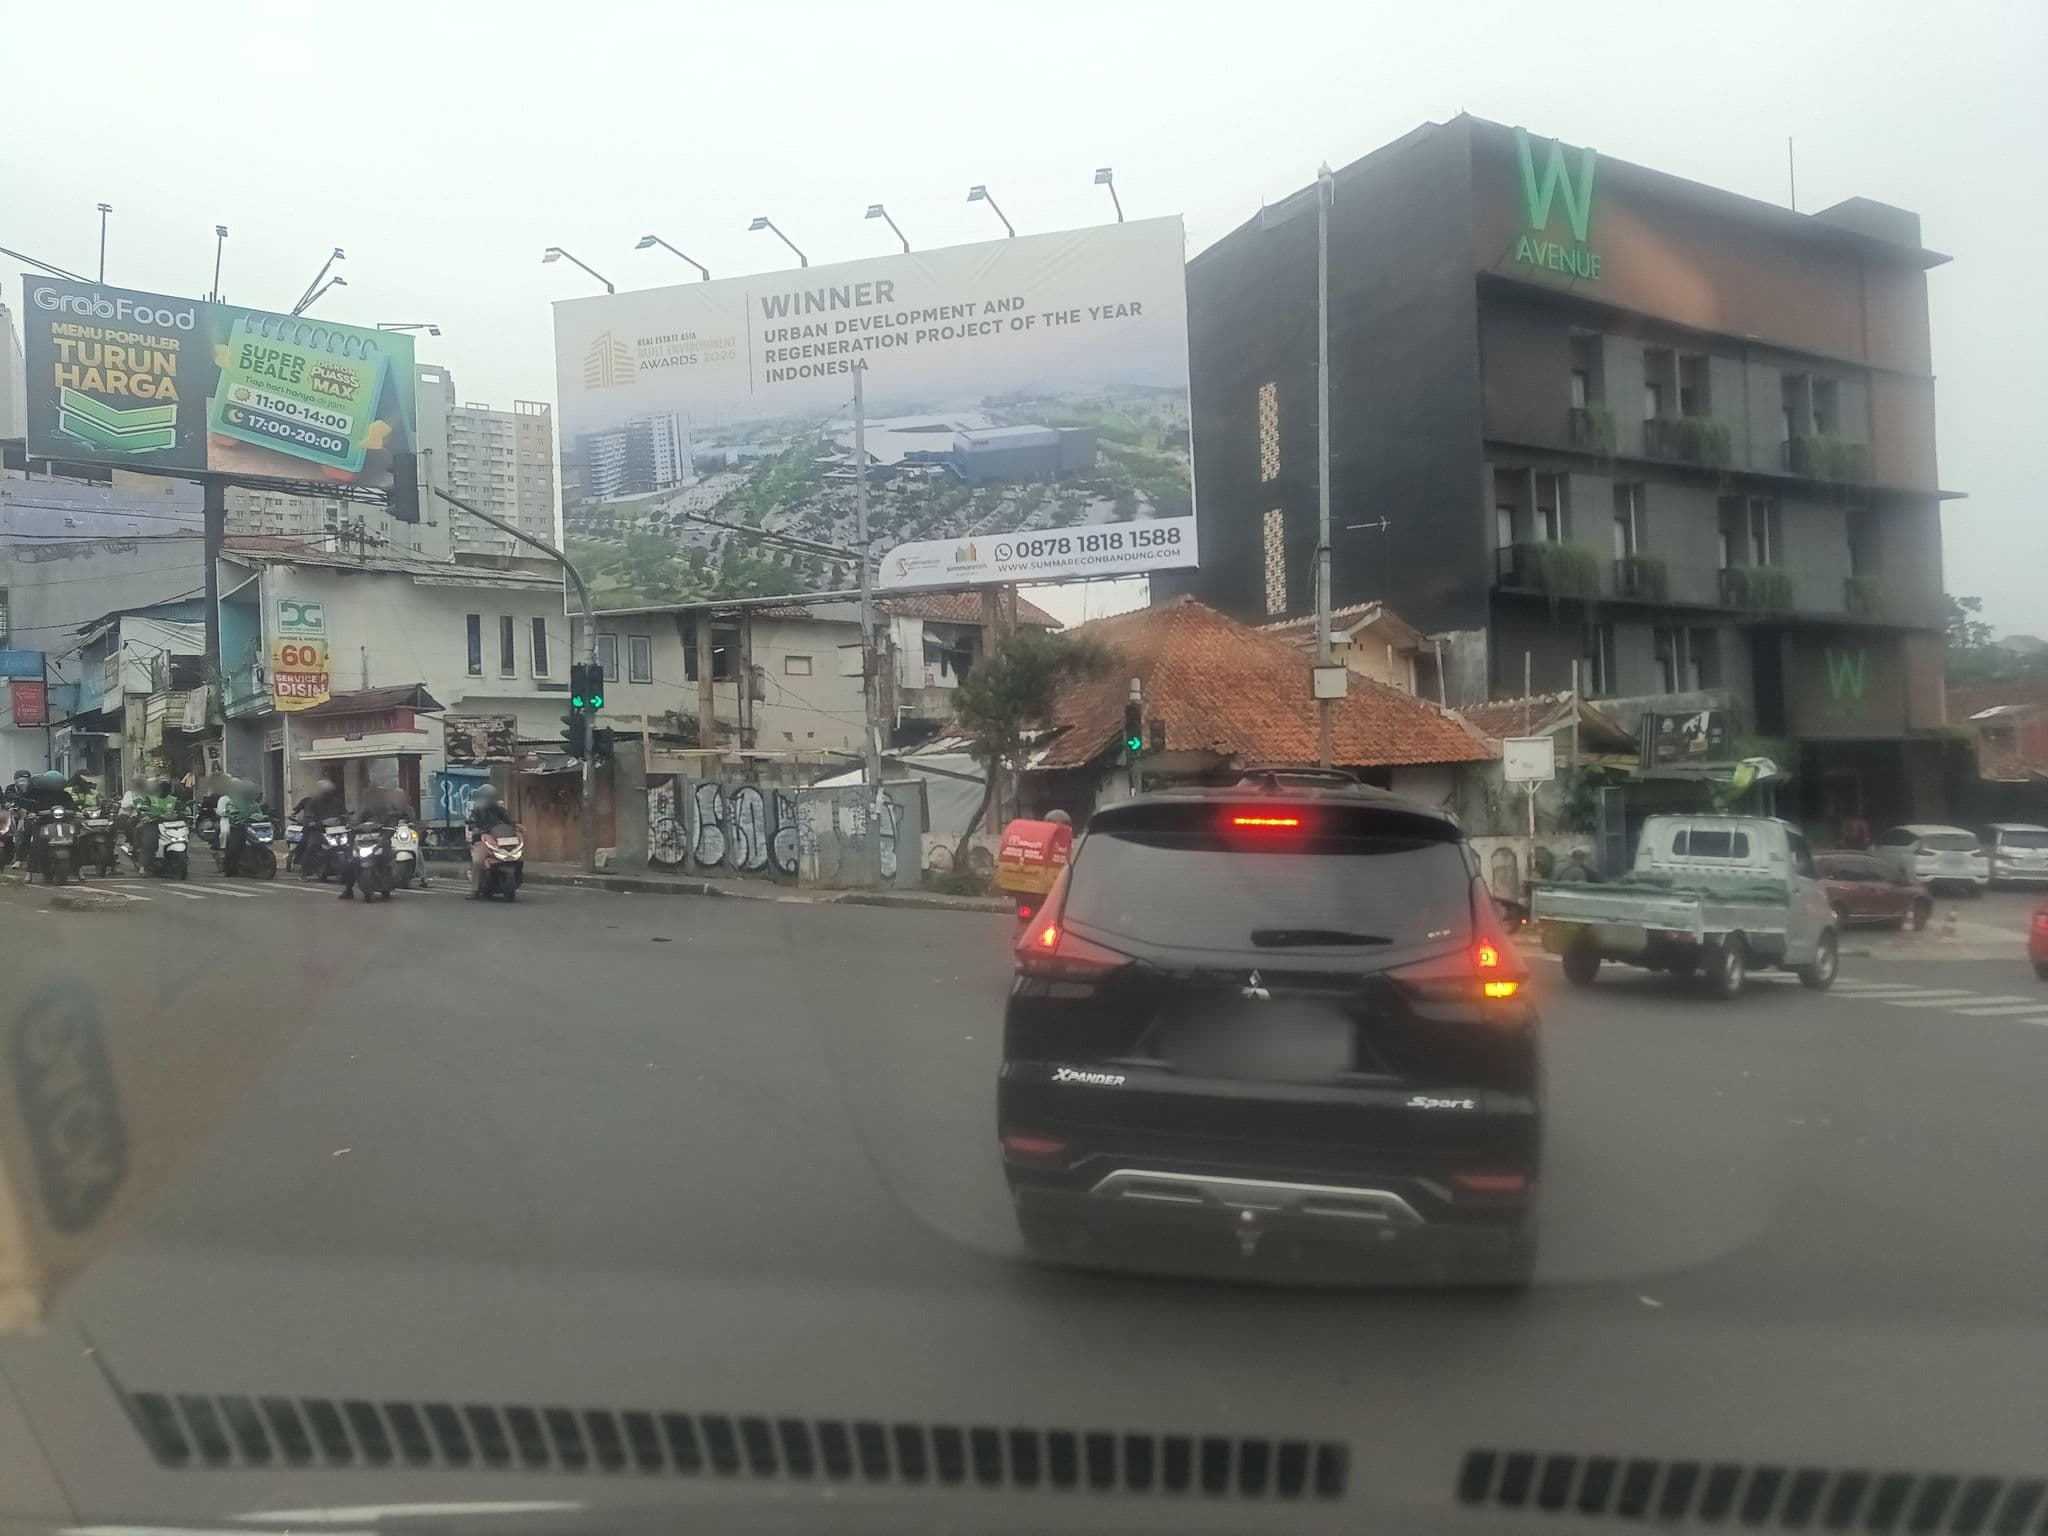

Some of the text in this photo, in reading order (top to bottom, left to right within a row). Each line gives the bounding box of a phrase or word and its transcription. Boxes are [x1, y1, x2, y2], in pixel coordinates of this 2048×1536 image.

[1512, 124, 1598, 242] W
[1514, 234, 1601, 281] AVENUE
[33, 287, 195, 331] GrabFood
[761, 279, 895, 319] WINNER
[764, 296, 1025, 344] URBAN DEVELOPMENT AND
[765, 301, 1143, 364] REGENERATION PROJECT OF THE YEAR
[51, 321, 181, 352] MENU POPULER
[53, 337, 177, 377] TURUN
[239, 355, 301, 385] DEALS
[241, 343, 306, 372] SUPER
[639, 353, 698, 370] AWARDS
[766, 357, 869, 384] INDONESIA
[54, 362, 180, 402] HARGA
[245, 376, 264, 388] Tiap
[313, 377, 353, 401] MAX
[255, 393, 347, 430] 11:00-14:00
[248, 415, 343, 452] 17:00-20:00
[1015, 527, 1182, 558] 0878 1818 1588
[998, 549, 1181, 573] WWW.SUMMARECONBANDUNG.COM
[281, 644, 317, 667] 60
[275, 673, 318, 684] SERVICE
[1051, 1066, 1126, 1087] XPANDER
[1406, 1096, 1475, 1110] Sport
